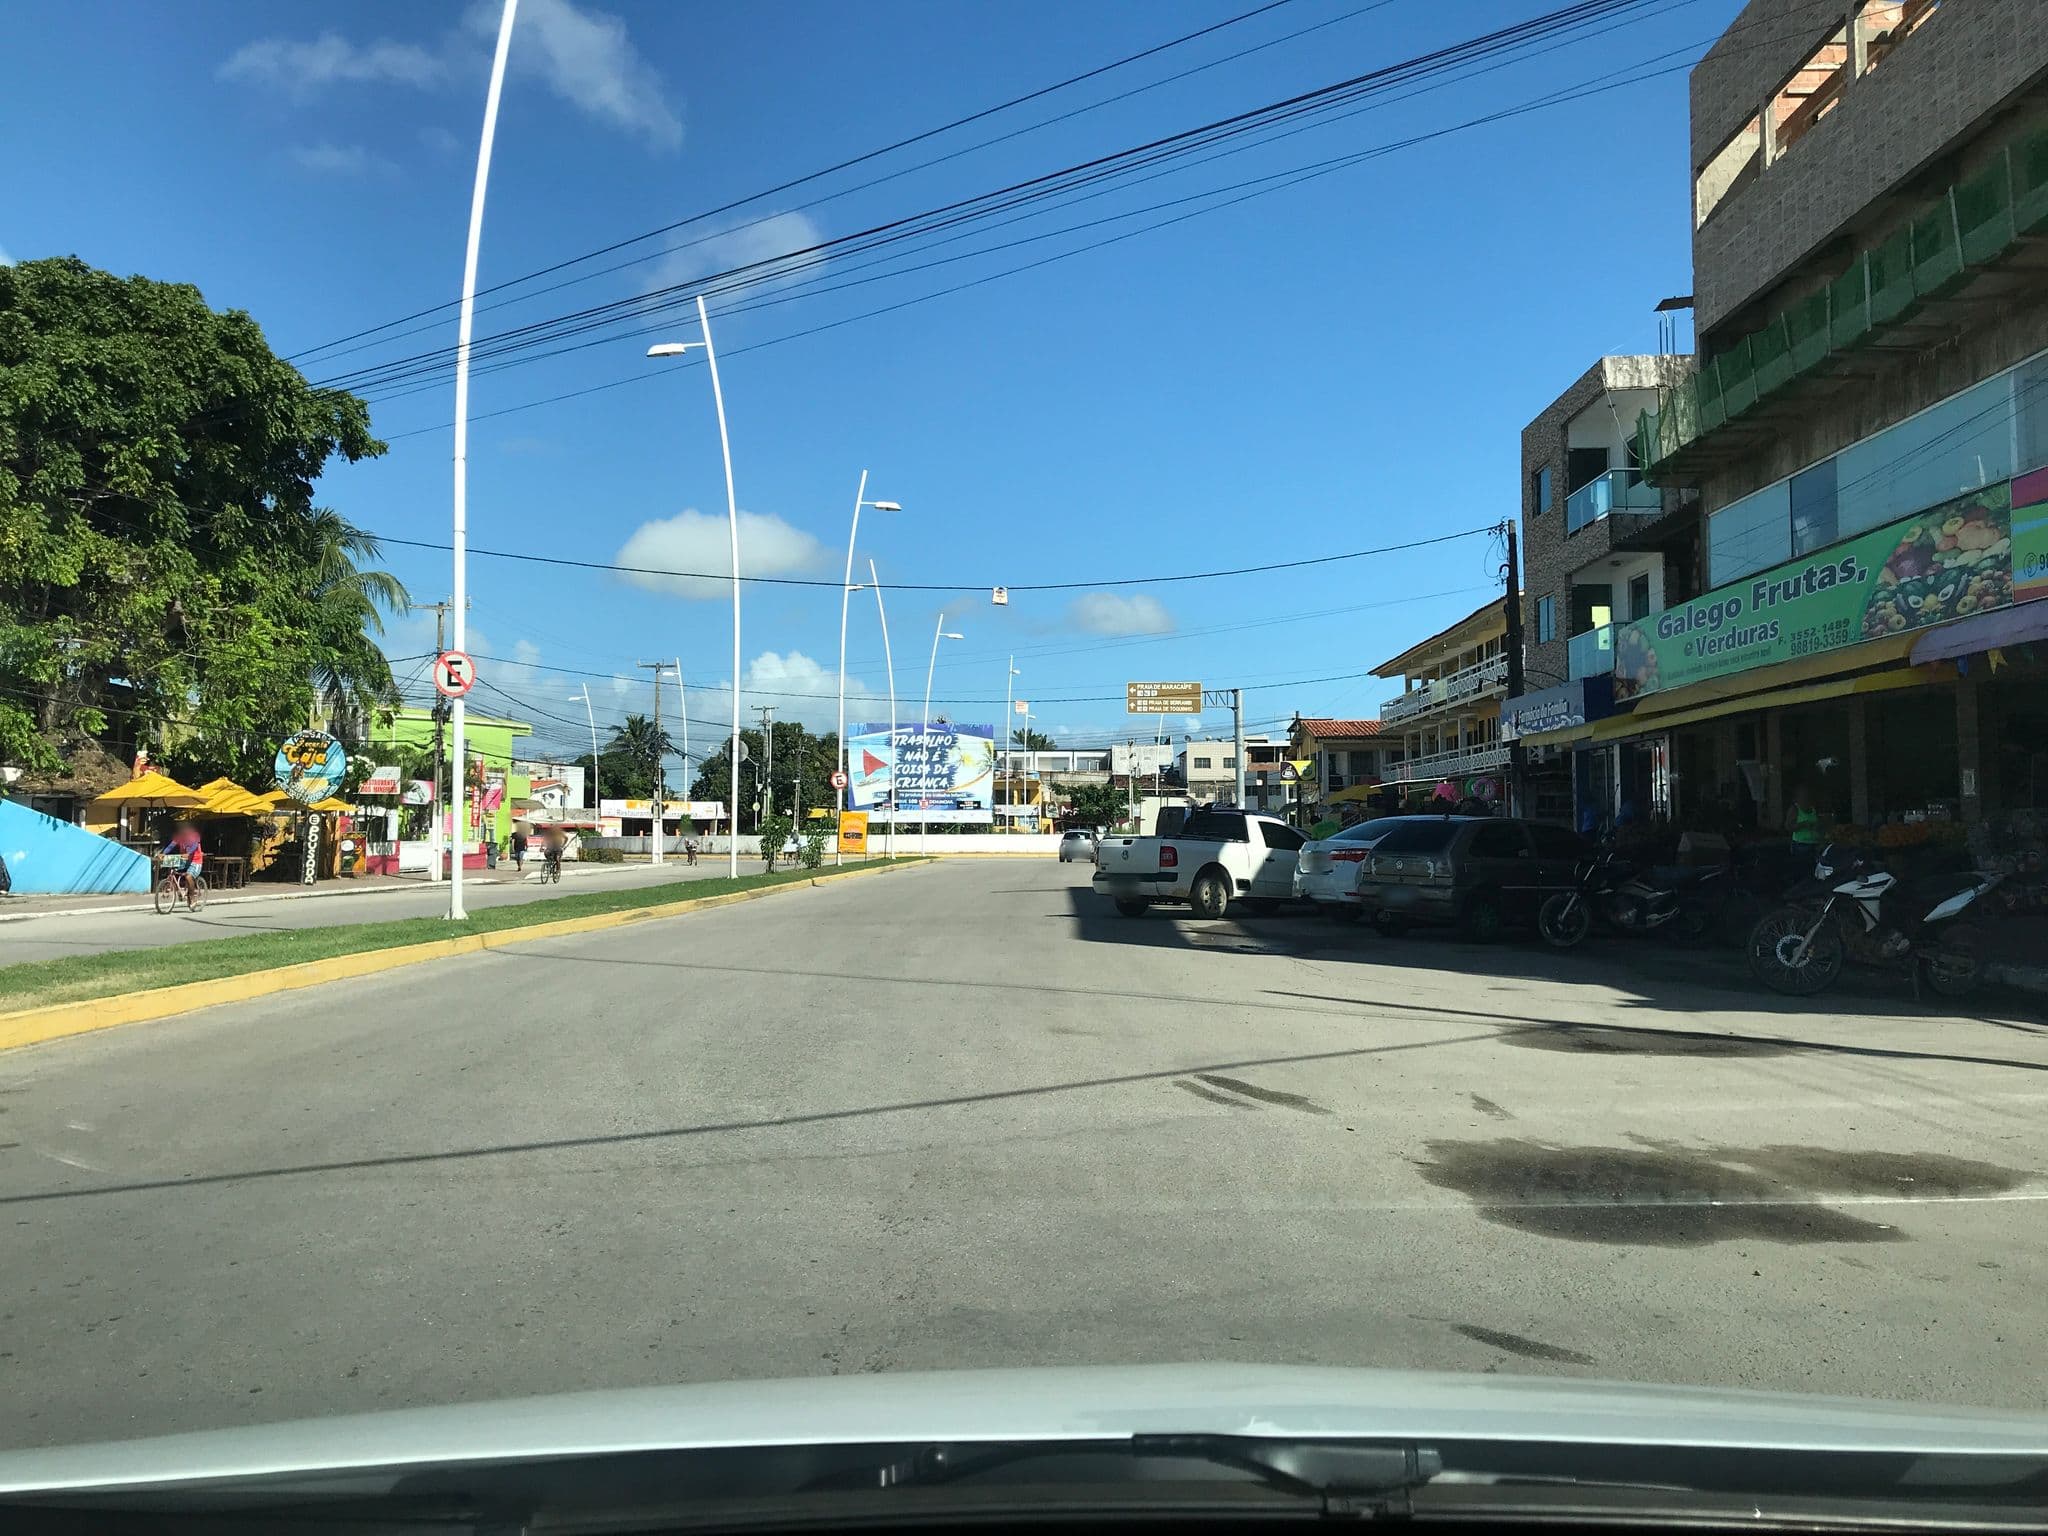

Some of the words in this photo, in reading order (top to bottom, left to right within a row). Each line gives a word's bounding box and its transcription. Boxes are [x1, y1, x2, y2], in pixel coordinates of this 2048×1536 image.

[1657, 597, 1743, 640] Galego
[1751, 556, 1869, 612] Frutas,
[1684, 642, 1694, 656] e
[1696, 619, 1780, 658] Verduras
[894, 735, 952, 747] TRABALHO
[904, 748, 929, 761] NÃO
[932, 747, 942, 761] É
[895, 764, 930, 775] COISA
[933, 764, 950, 775] DE
[304, 825, 320, 884] POUSADA
